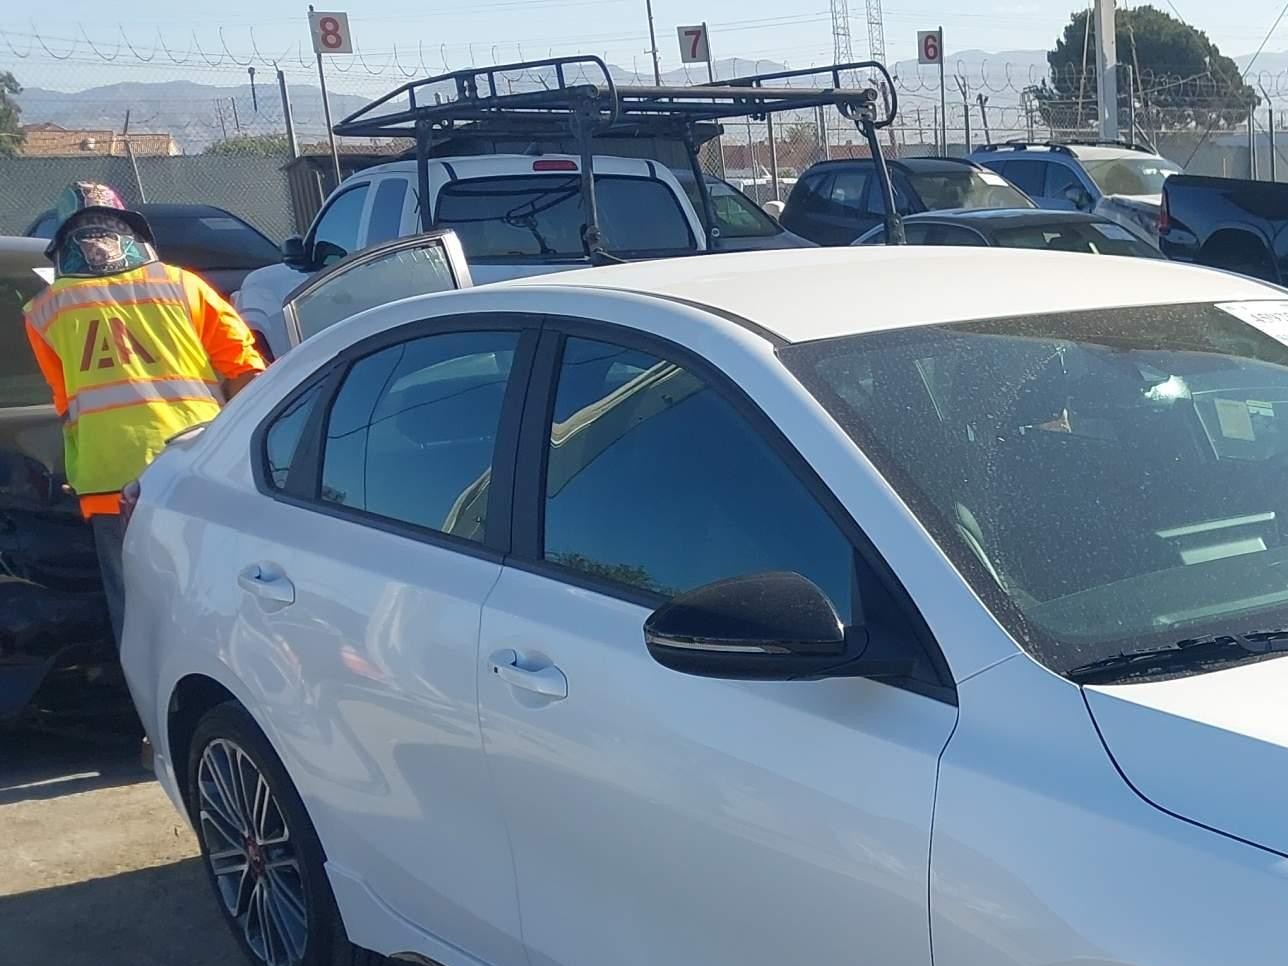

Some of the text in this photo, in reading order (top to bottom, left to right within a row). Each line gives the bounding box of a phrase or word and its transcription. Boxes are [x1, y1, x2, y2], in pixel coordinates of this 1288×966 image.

[320, 17, 342, 49] 8
[684, 30, 702, 59] 7
[924, 34, 938, 60] 6
